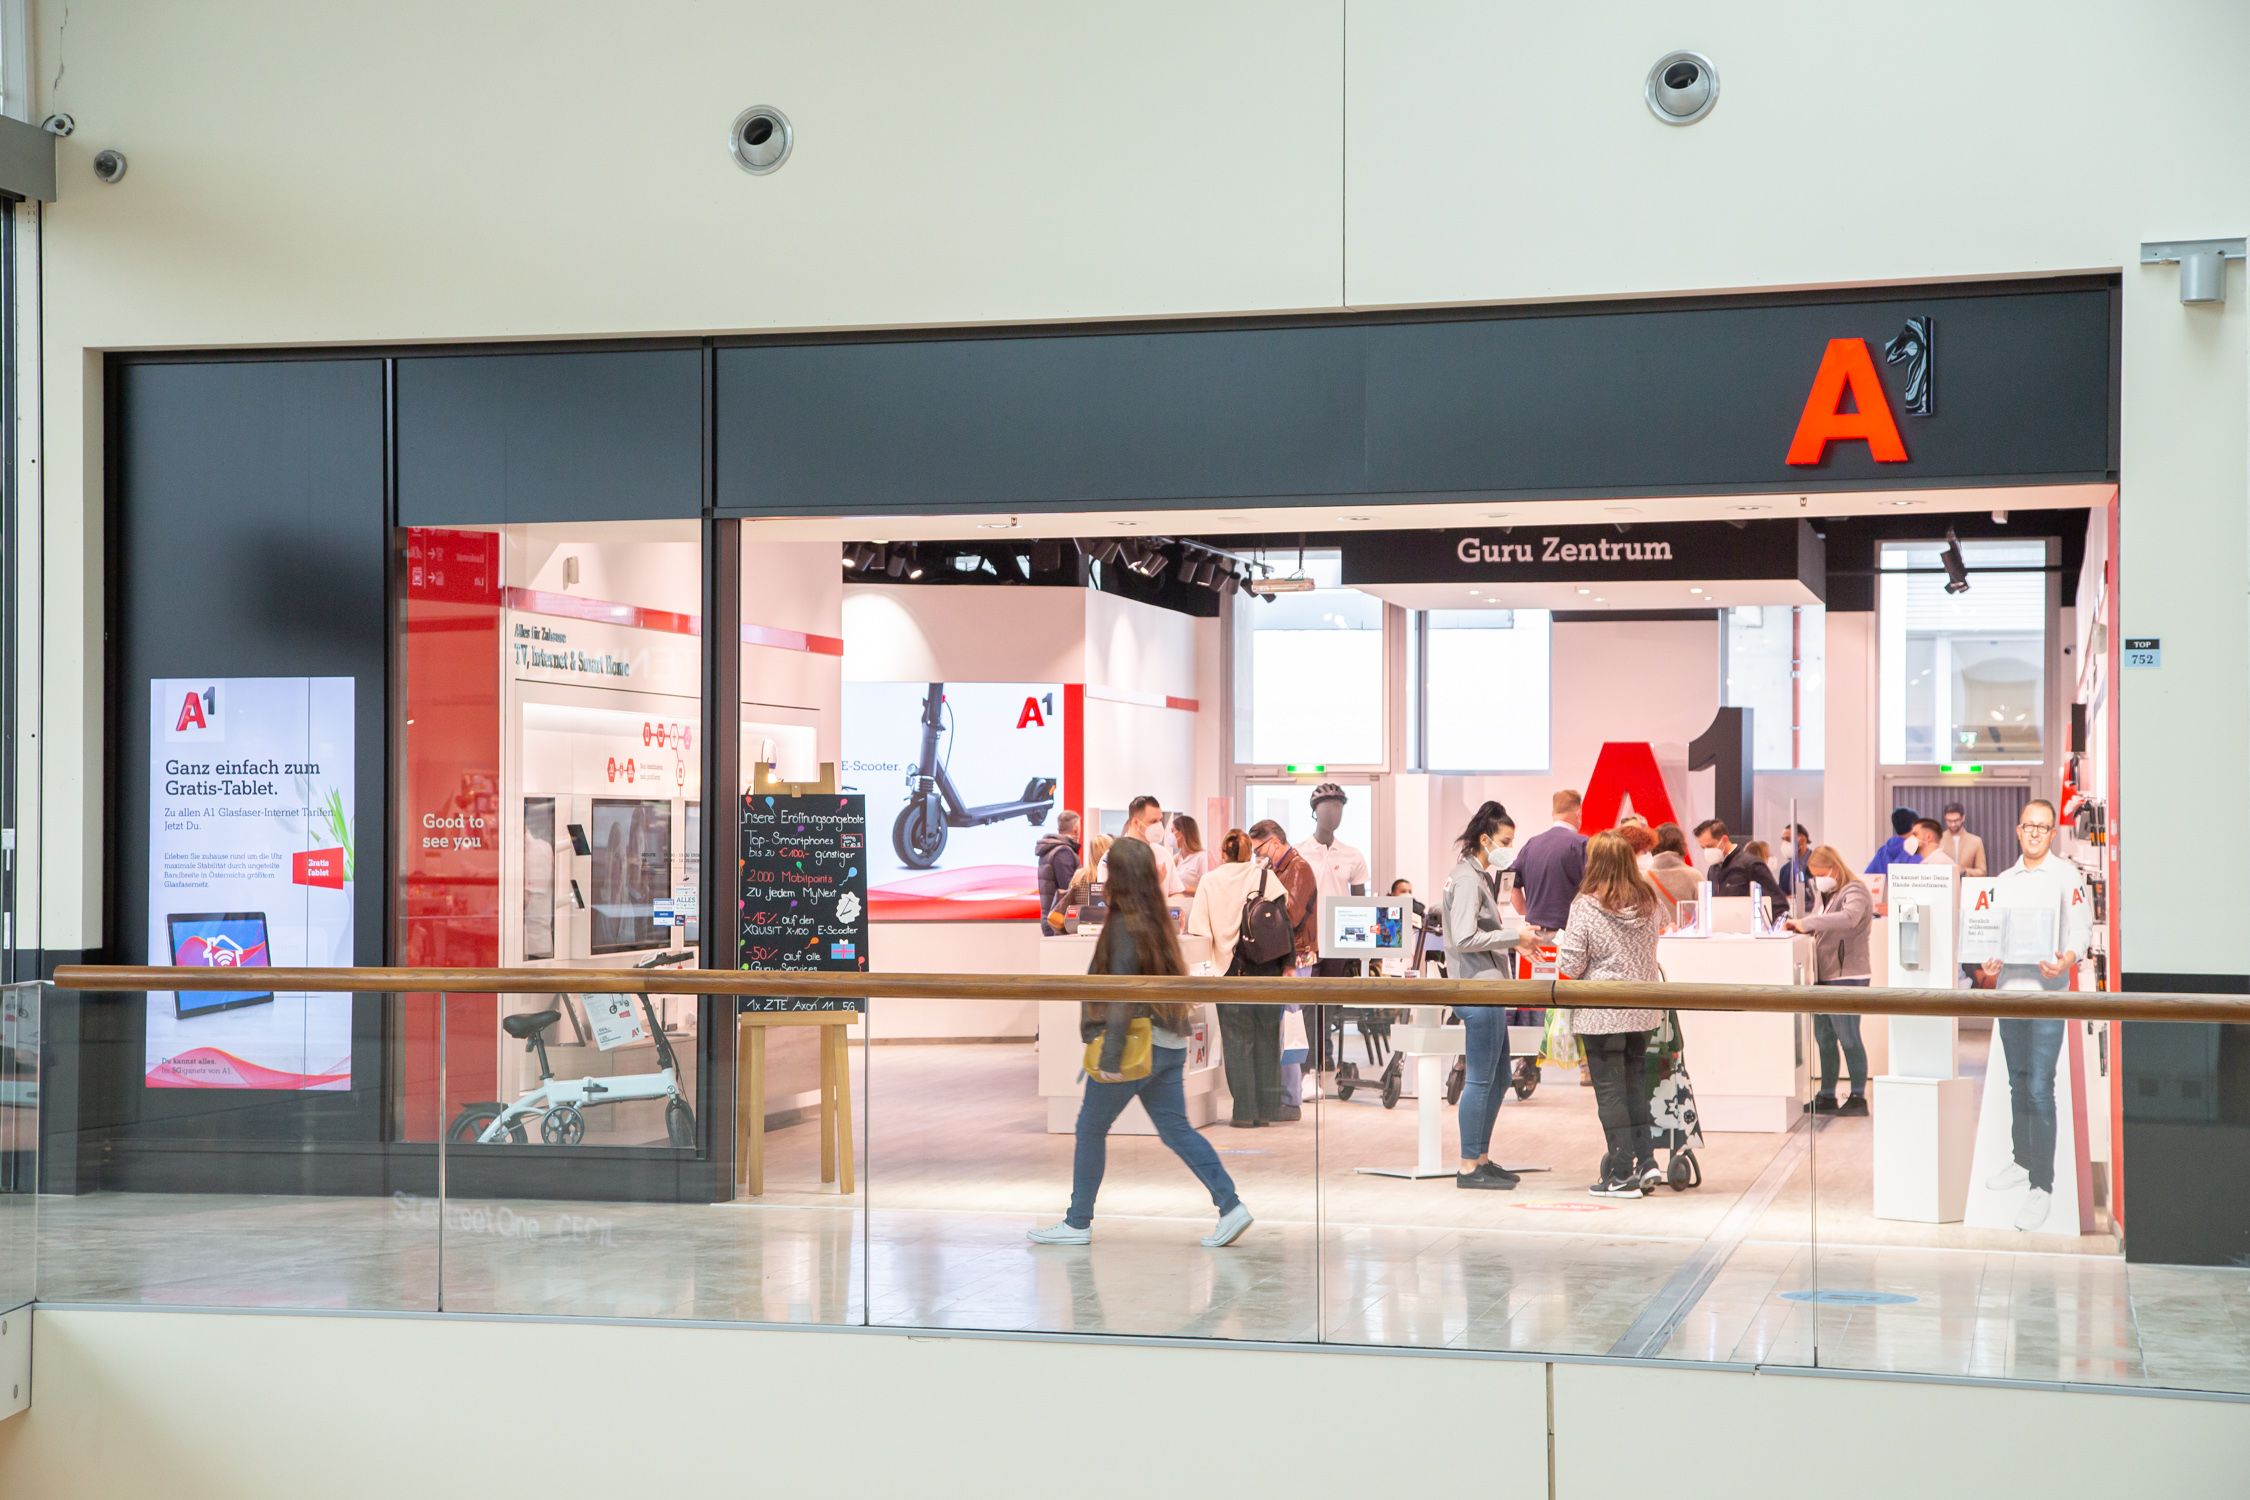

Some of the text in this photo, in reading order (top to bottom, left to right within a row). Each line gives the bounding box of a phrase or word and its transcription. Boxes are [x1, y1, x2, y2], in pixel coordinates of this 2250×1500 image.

[1785, 316, 1934, 465] A1
[1457, 536, 1673, 563] Guru Zentrum
[2133, 641, 2152, 649] TOP
[514, 643, 530, 669] TV,
[531, 645, 568, 670] Internet
[578, 651, 604, 674] Smart
[605, 655, 630, 677] Home
[2131, 654, 2154, 665] 752
[176, 686, 216, 732] A1
[1016, 692, 1054, 729] A1
[165, 759, 321, 776] Ganz einfach zum
[841, 761, 901, 773] E-Scooter.
[165, 780, 279, 796] Gratis-Tablet.
[1579, 706, 1755, 867] A1
[164, 807, 337, 818] Zu allen A1 Glasfaser-Internet Tarifen.
[780, 810, 865, 832] Eröffnungsangebote
[164, 821, 202, 832] Jetzt Du.
[422, 813, 485, 830] Good to
[422, 836, 482, 851] see you
[749, 846, 762, 858] bis
[814, 850, 856, 868] günstiger
[747, 869, 833, 887] 2000 Mobilpoints
[765, 887, 796, 901] jedem
[802, 887, 837, 905] MyNext
[1975, 888, 1995, 911] A1
[2071, 885, 2085, 906] A1
[782, 915, 798, 926] auf
[799, 915, 814, 924] den
[783, 950, 802, 961] auf
[806, 952, 821, 961] alle
[746, 999, 761, 1011] 1x
[763, 999, 788, 1011] ZTE
[792, 1000, 818, 1011] Axon
[842, 1001, 855, 1012] 5G
